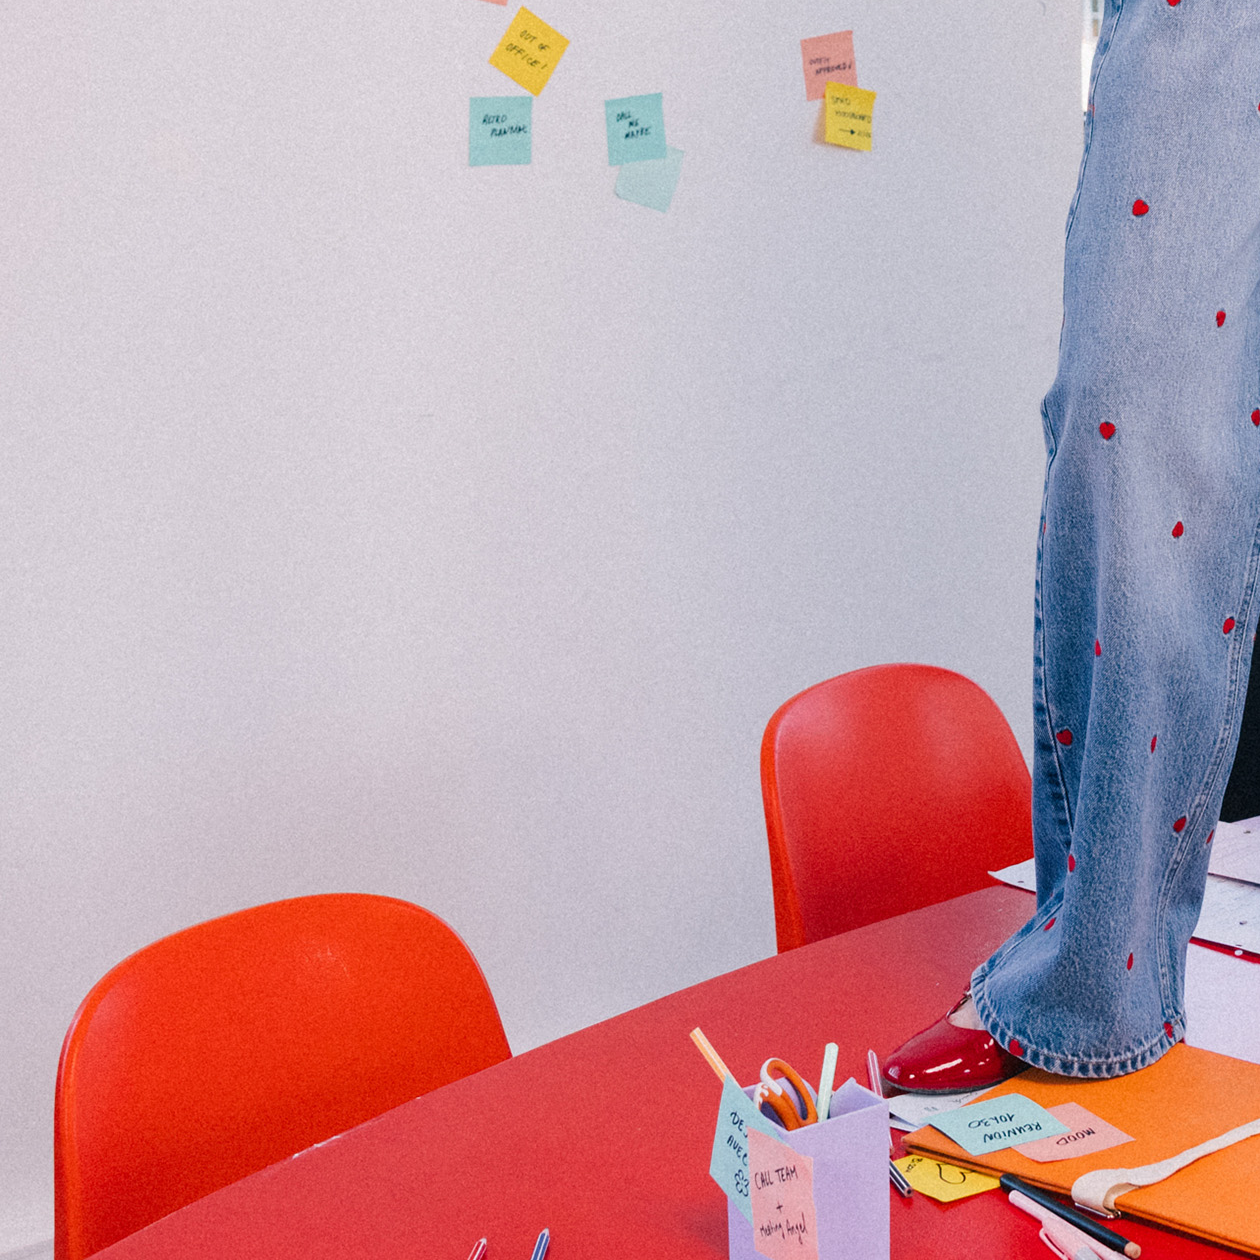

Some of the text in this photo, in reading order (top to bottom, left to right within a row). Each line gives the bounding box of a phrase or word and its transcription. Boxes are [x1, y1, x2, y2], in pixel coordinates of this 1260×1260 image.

[519, 29, 551, 52] OUT OF
[616, 110, 632, 122] CALL
[628, 118, 640, 129] ME
[624, 125, 652, 140] MAYBE
[1056, 1127, 1096, 1146] MOOD
[754, 1164, 799, 1190] CALL TEAM
[786, 1211, 808, 1245] Angel
